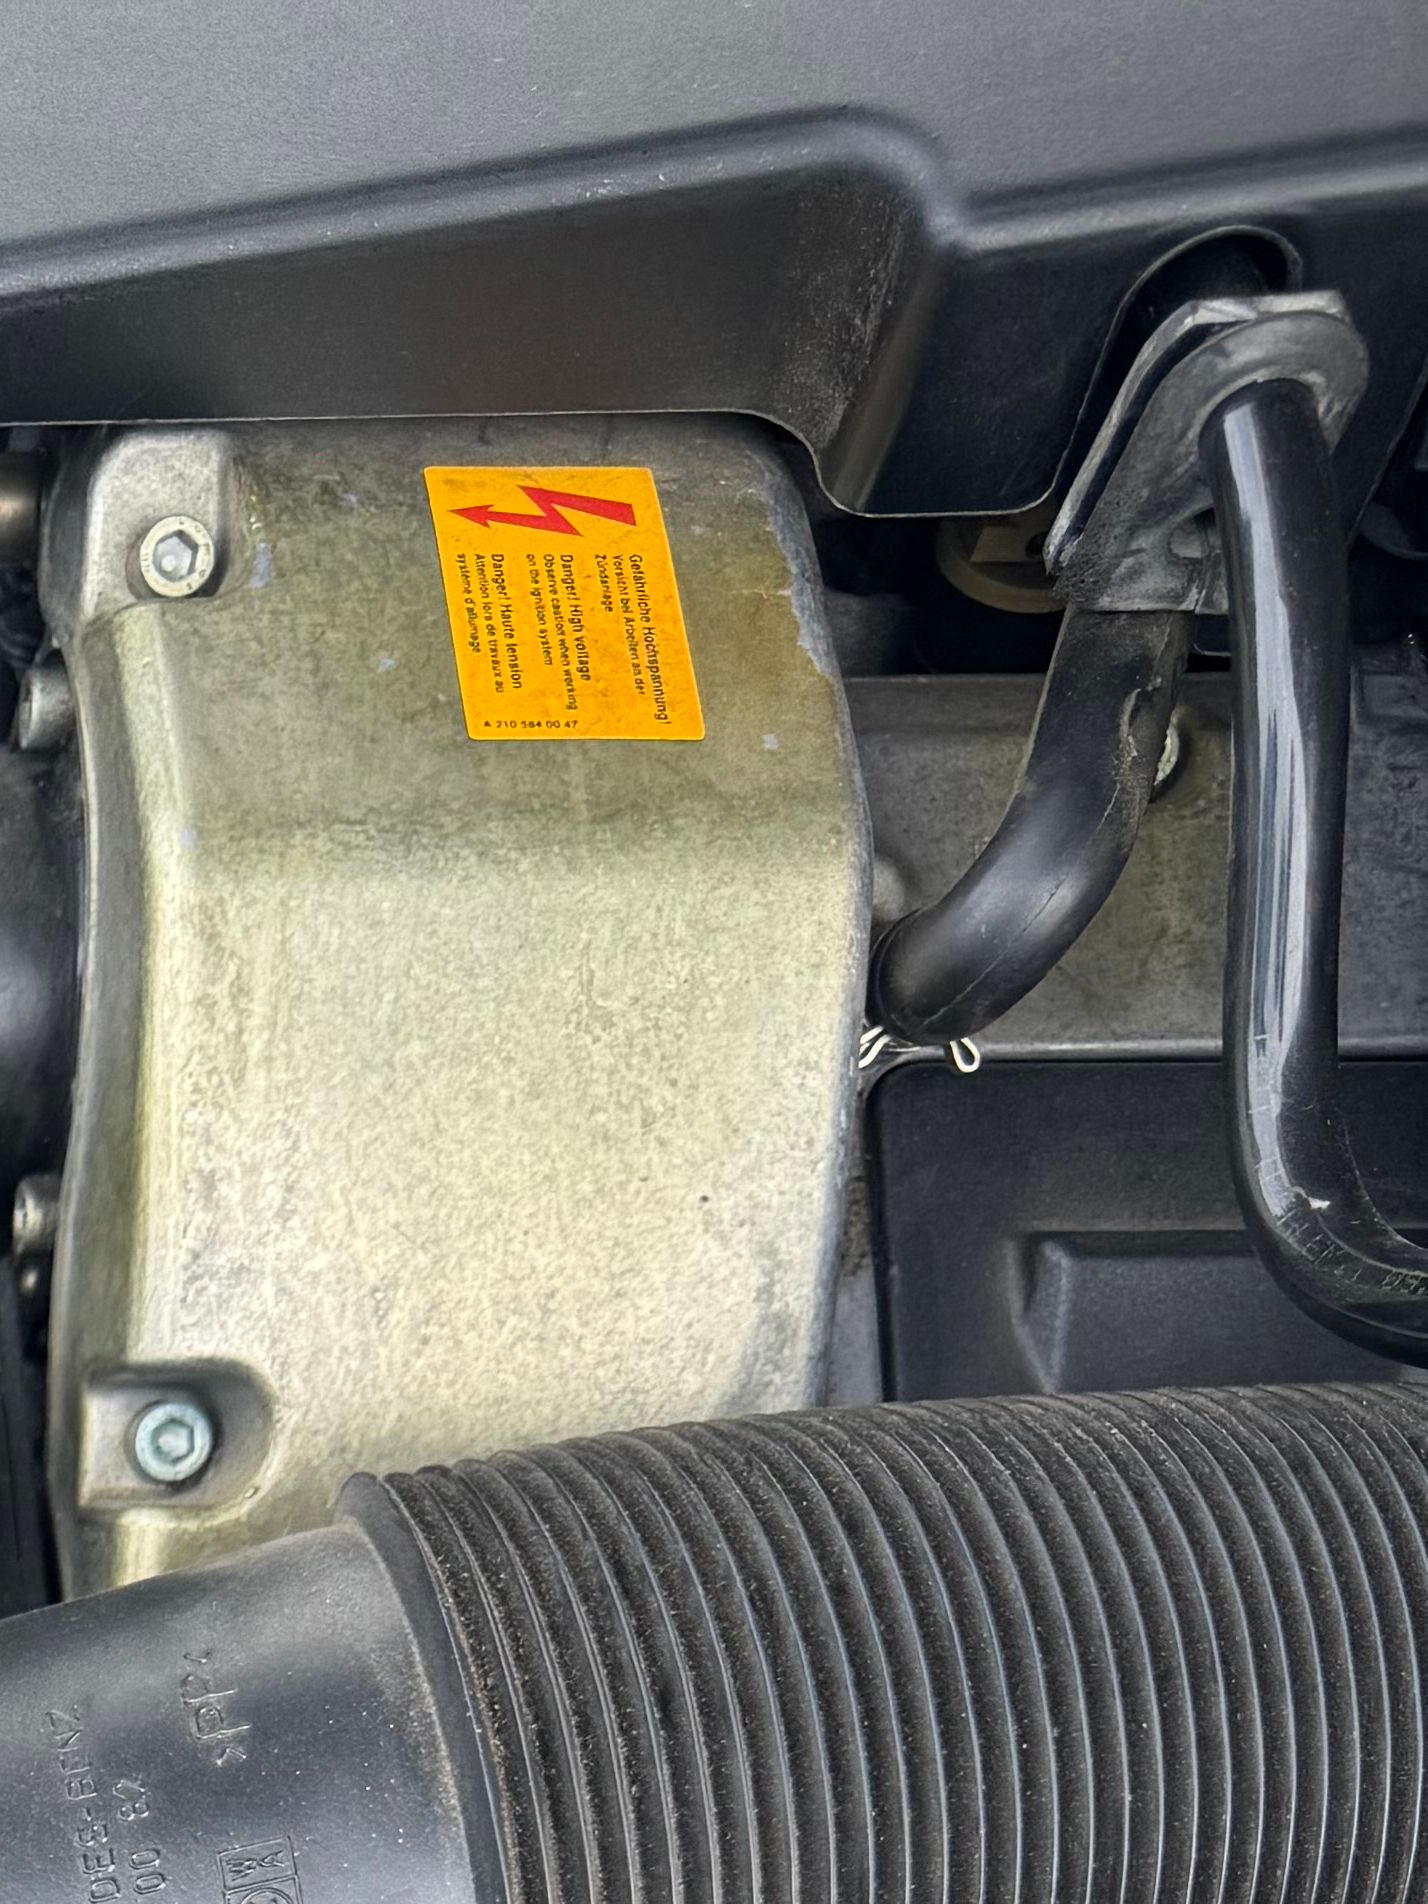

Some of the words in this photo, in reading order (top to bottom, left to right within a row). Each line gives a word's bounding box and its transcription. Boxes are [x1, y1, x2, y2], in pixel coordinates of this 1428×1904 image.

[491, 554, 512, 601] Danger!
[560, 554, 580, 601] Danger!
[501, 604, 515, 639] Haute
[568, 604, 585, 632] High
